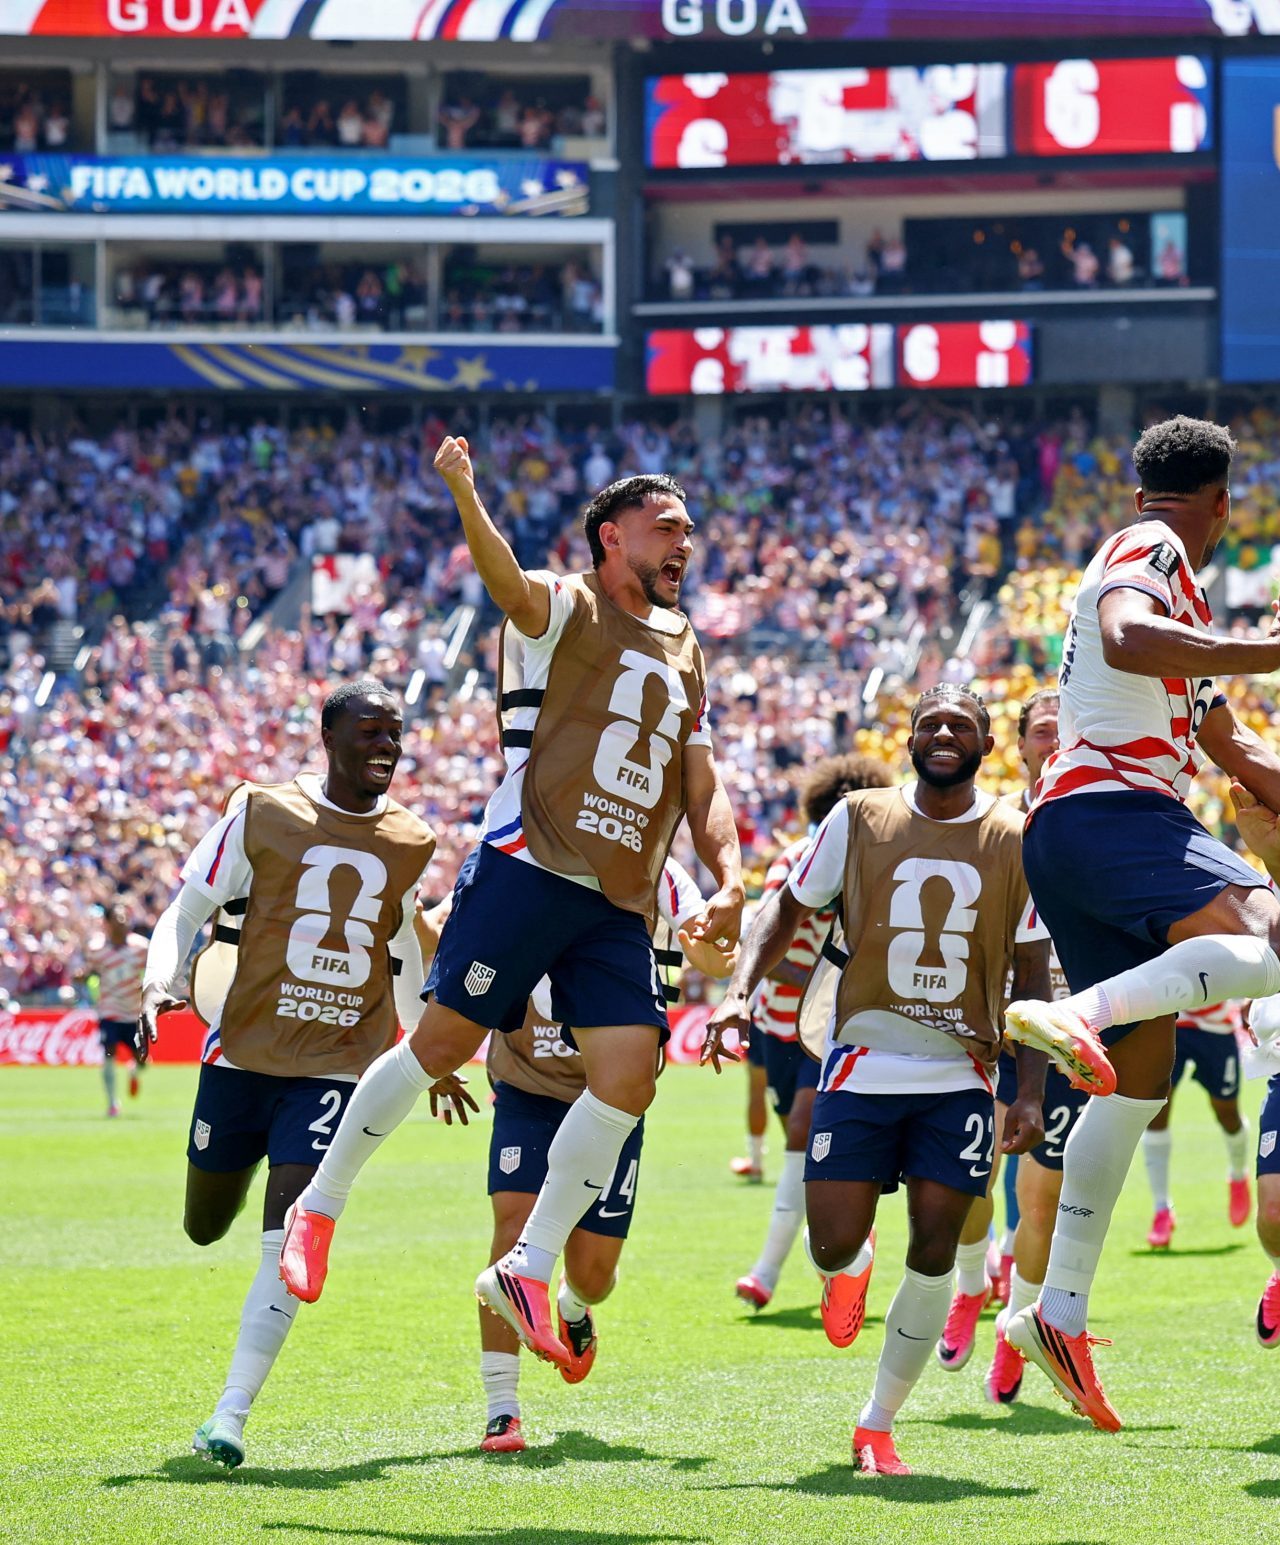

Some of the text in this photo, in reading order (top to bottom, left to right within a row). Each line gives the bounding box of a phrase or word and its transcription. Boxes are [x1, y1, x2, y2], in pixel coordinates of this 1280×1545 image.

[70, 166, 500, 203] FIFA WORLD CUP 2026
[616, 766, 650, 793] FIFA
[583, 792, 636, 821] WORLD
[575, 810, 643, 853] 2026
[311, 955, 351, 976] FIFA
[472, 963, 494, 981] USA
[913, 972, 947, 990] FIFA
[281, 982, 365, 1008] WORLD CUP
[276, 998, 362, 1028] 2026
[943, 1008, 964, 1021] CUP
[533, 1039, 582, 1058] 20
[814, 1133, 831, 1145] USA
[502, 1148, 520, 1159] USA
